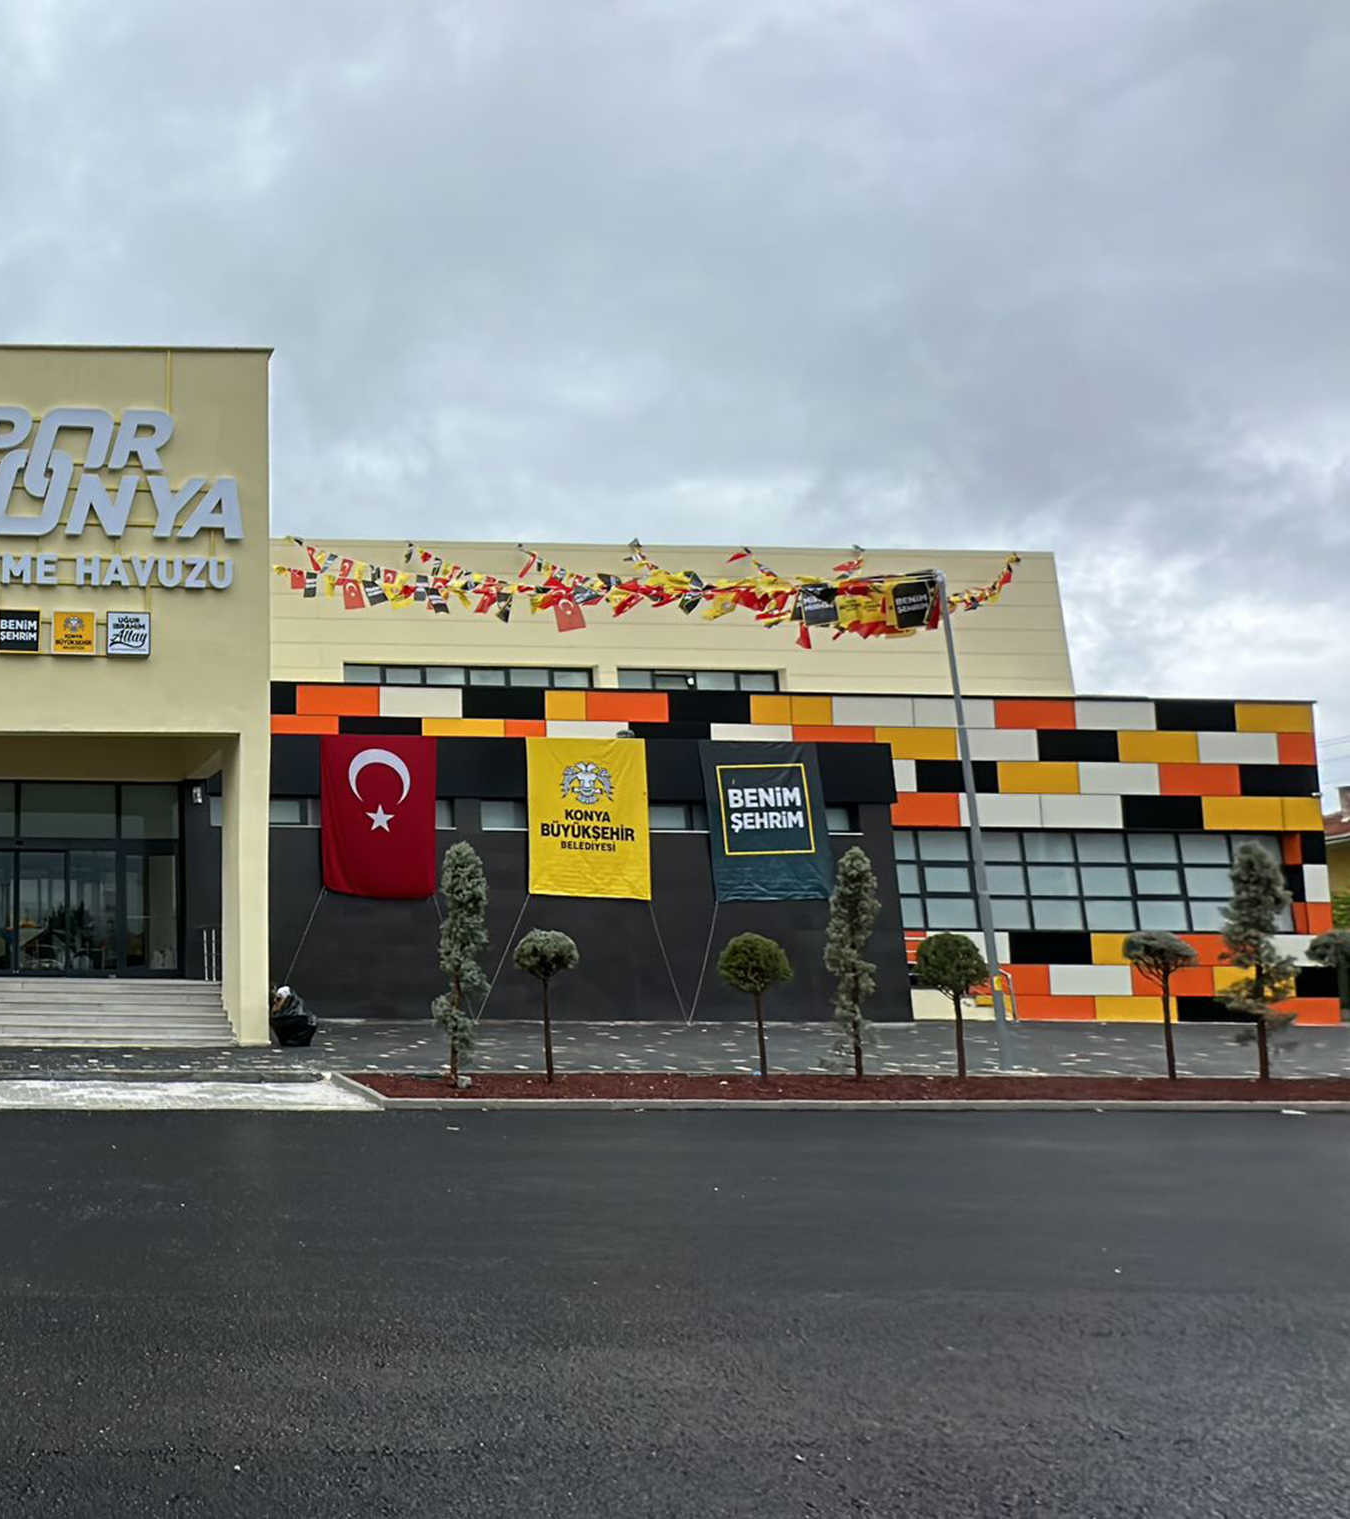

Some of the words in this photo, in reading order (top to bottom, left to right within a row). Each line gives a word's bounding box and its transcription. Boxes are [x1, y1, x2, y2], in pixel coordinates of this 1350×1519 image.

[75, 554, 234, 590] HAVUZU
[565, 809, 611, 822] KONYA
[540, 820, 635, 841] BÜYÜKŞEHİR
